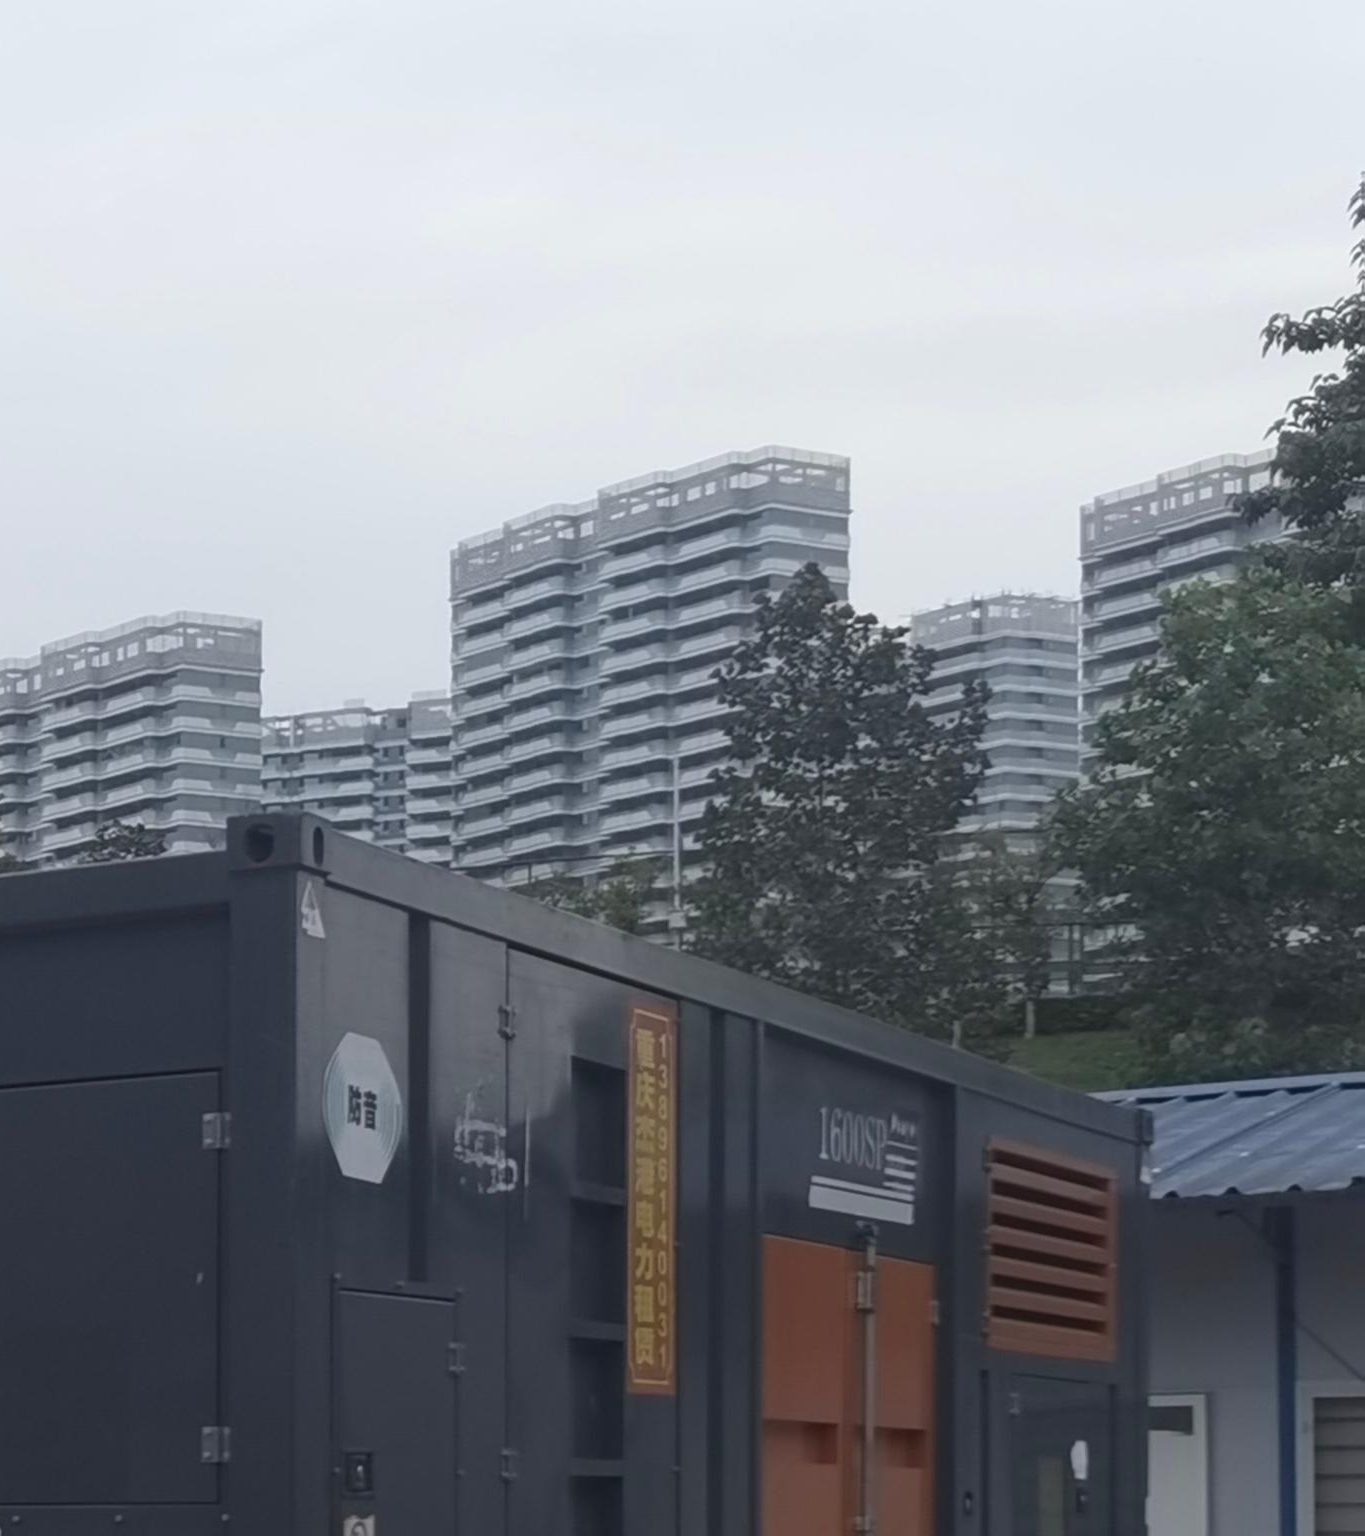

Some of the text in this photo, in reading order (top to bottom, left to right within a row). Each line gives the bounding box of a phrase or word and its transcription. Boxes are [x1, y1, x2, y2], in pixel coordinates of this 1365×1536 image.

[348, 1084, 377, 1130] 防音
[819, 1107, 887, 1170] 1600SP
[657, 1034, 668, 1368] 13896140031
